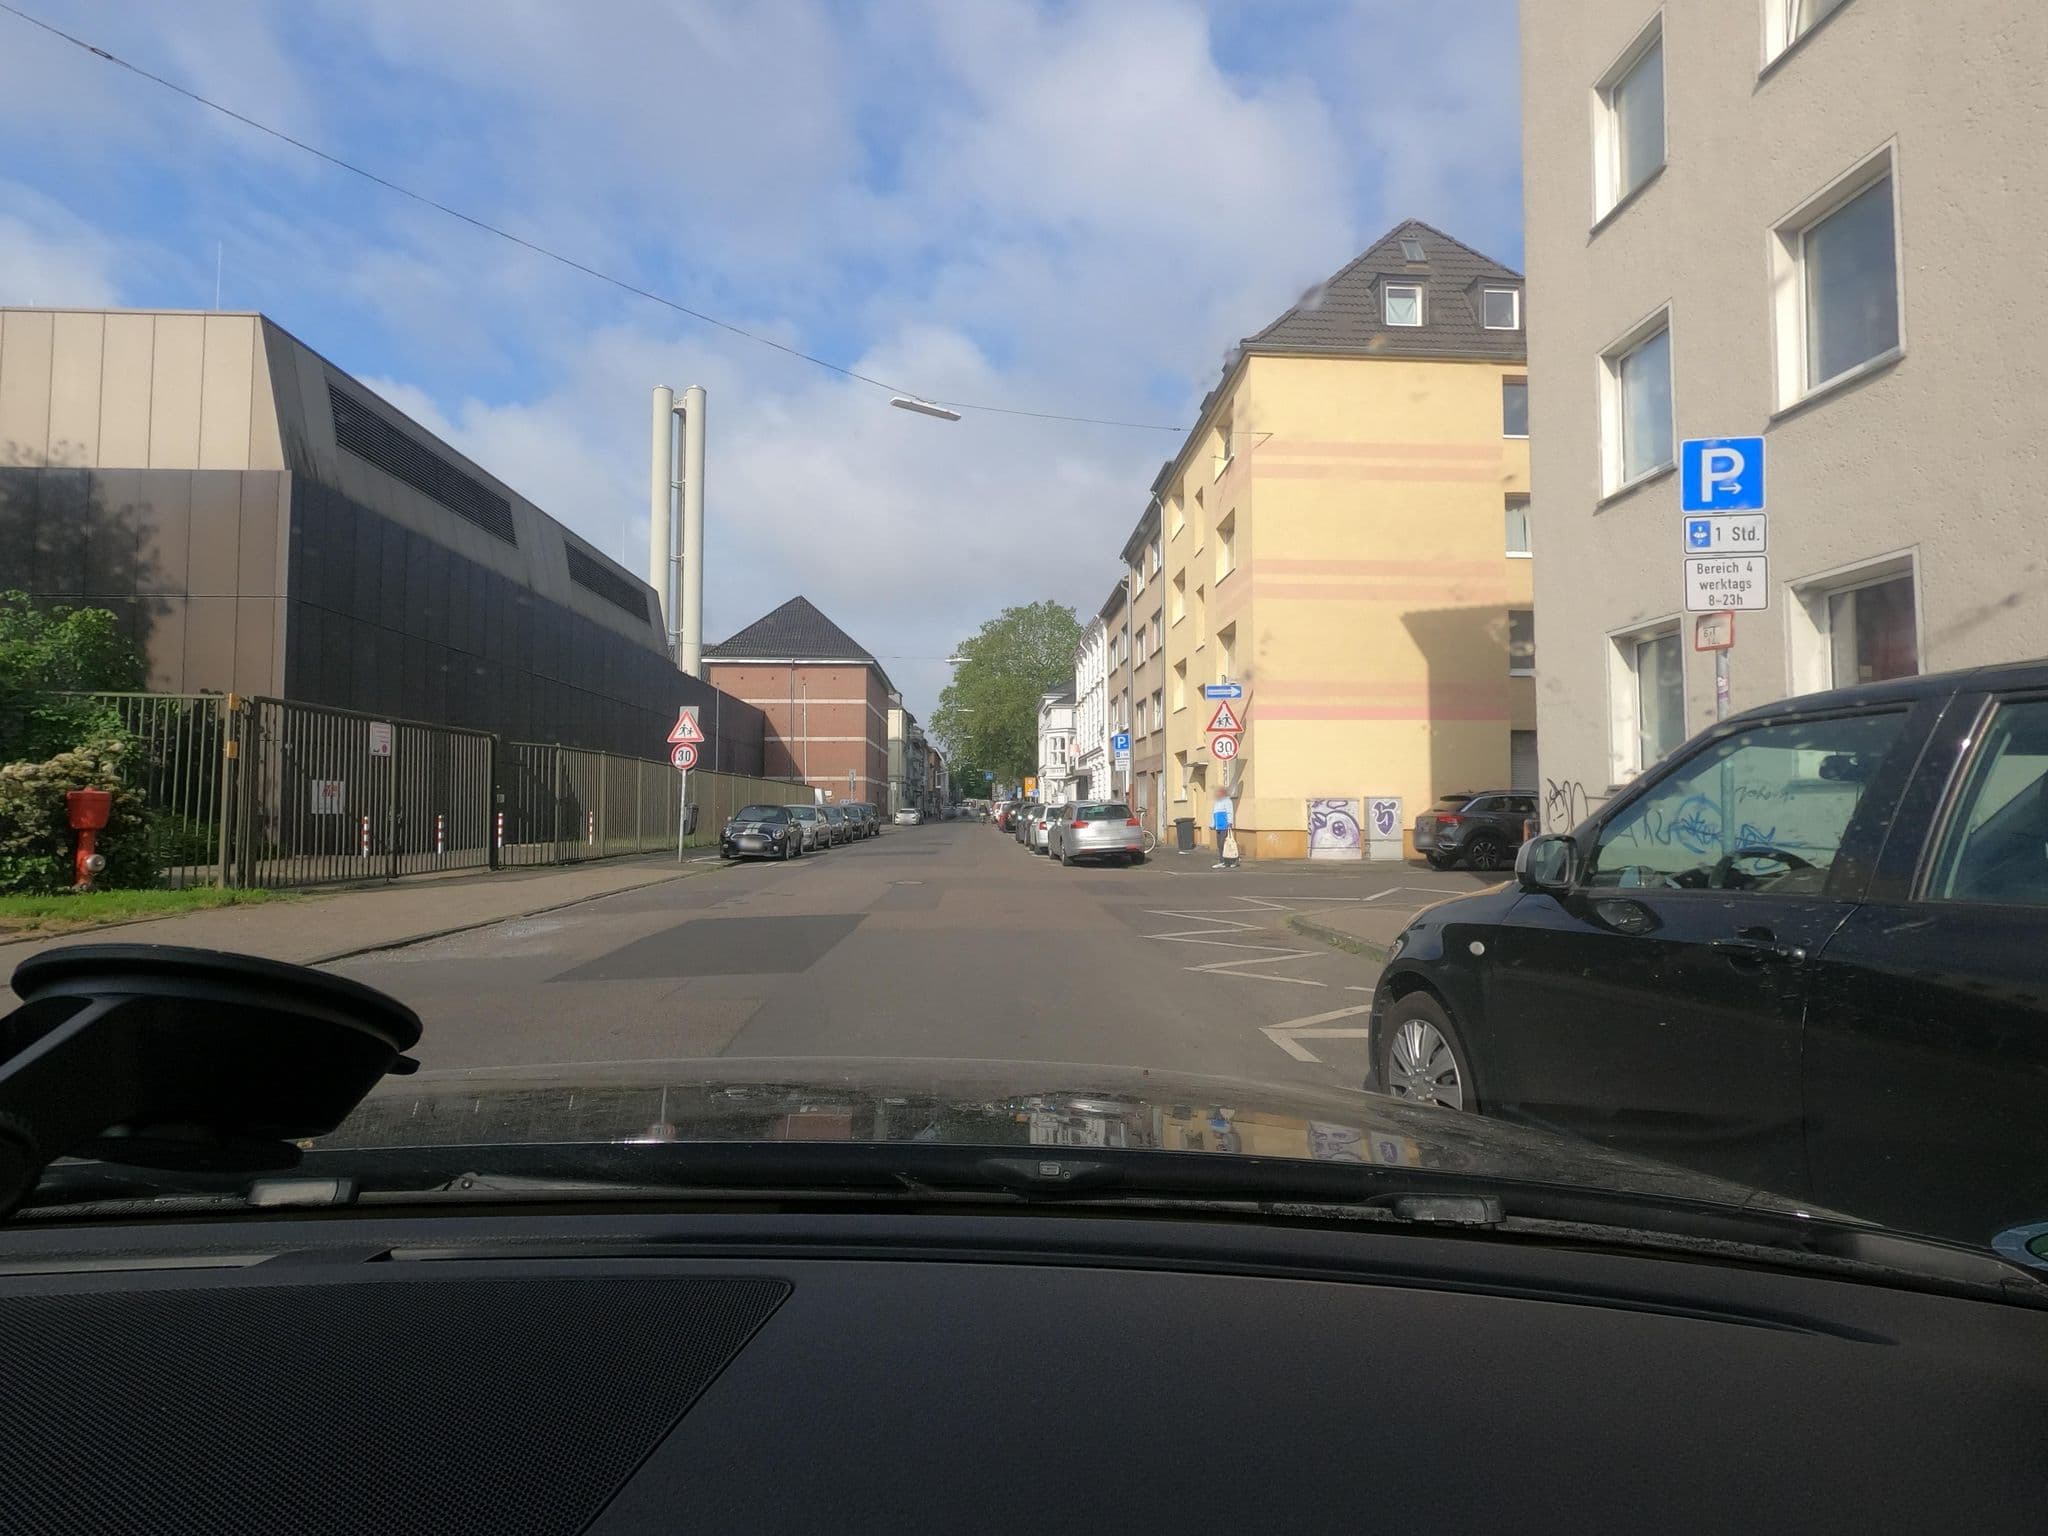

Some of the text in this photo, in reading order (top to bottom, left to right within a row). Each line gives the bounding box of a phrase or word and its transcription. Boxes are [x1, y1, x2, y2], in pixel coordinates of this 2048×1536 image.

[1702, 448, 1744, 502] P
[1716, 526, 1760, 541] 1 Std.
[1697, 561, 1753, 574] Bereich 4
[1699, 579, 1752, 592] werktags
[1117, 736, 1126, 749] P
[1217, 741, 1232, 753] 30
[678, 750, 691, 761] 30
